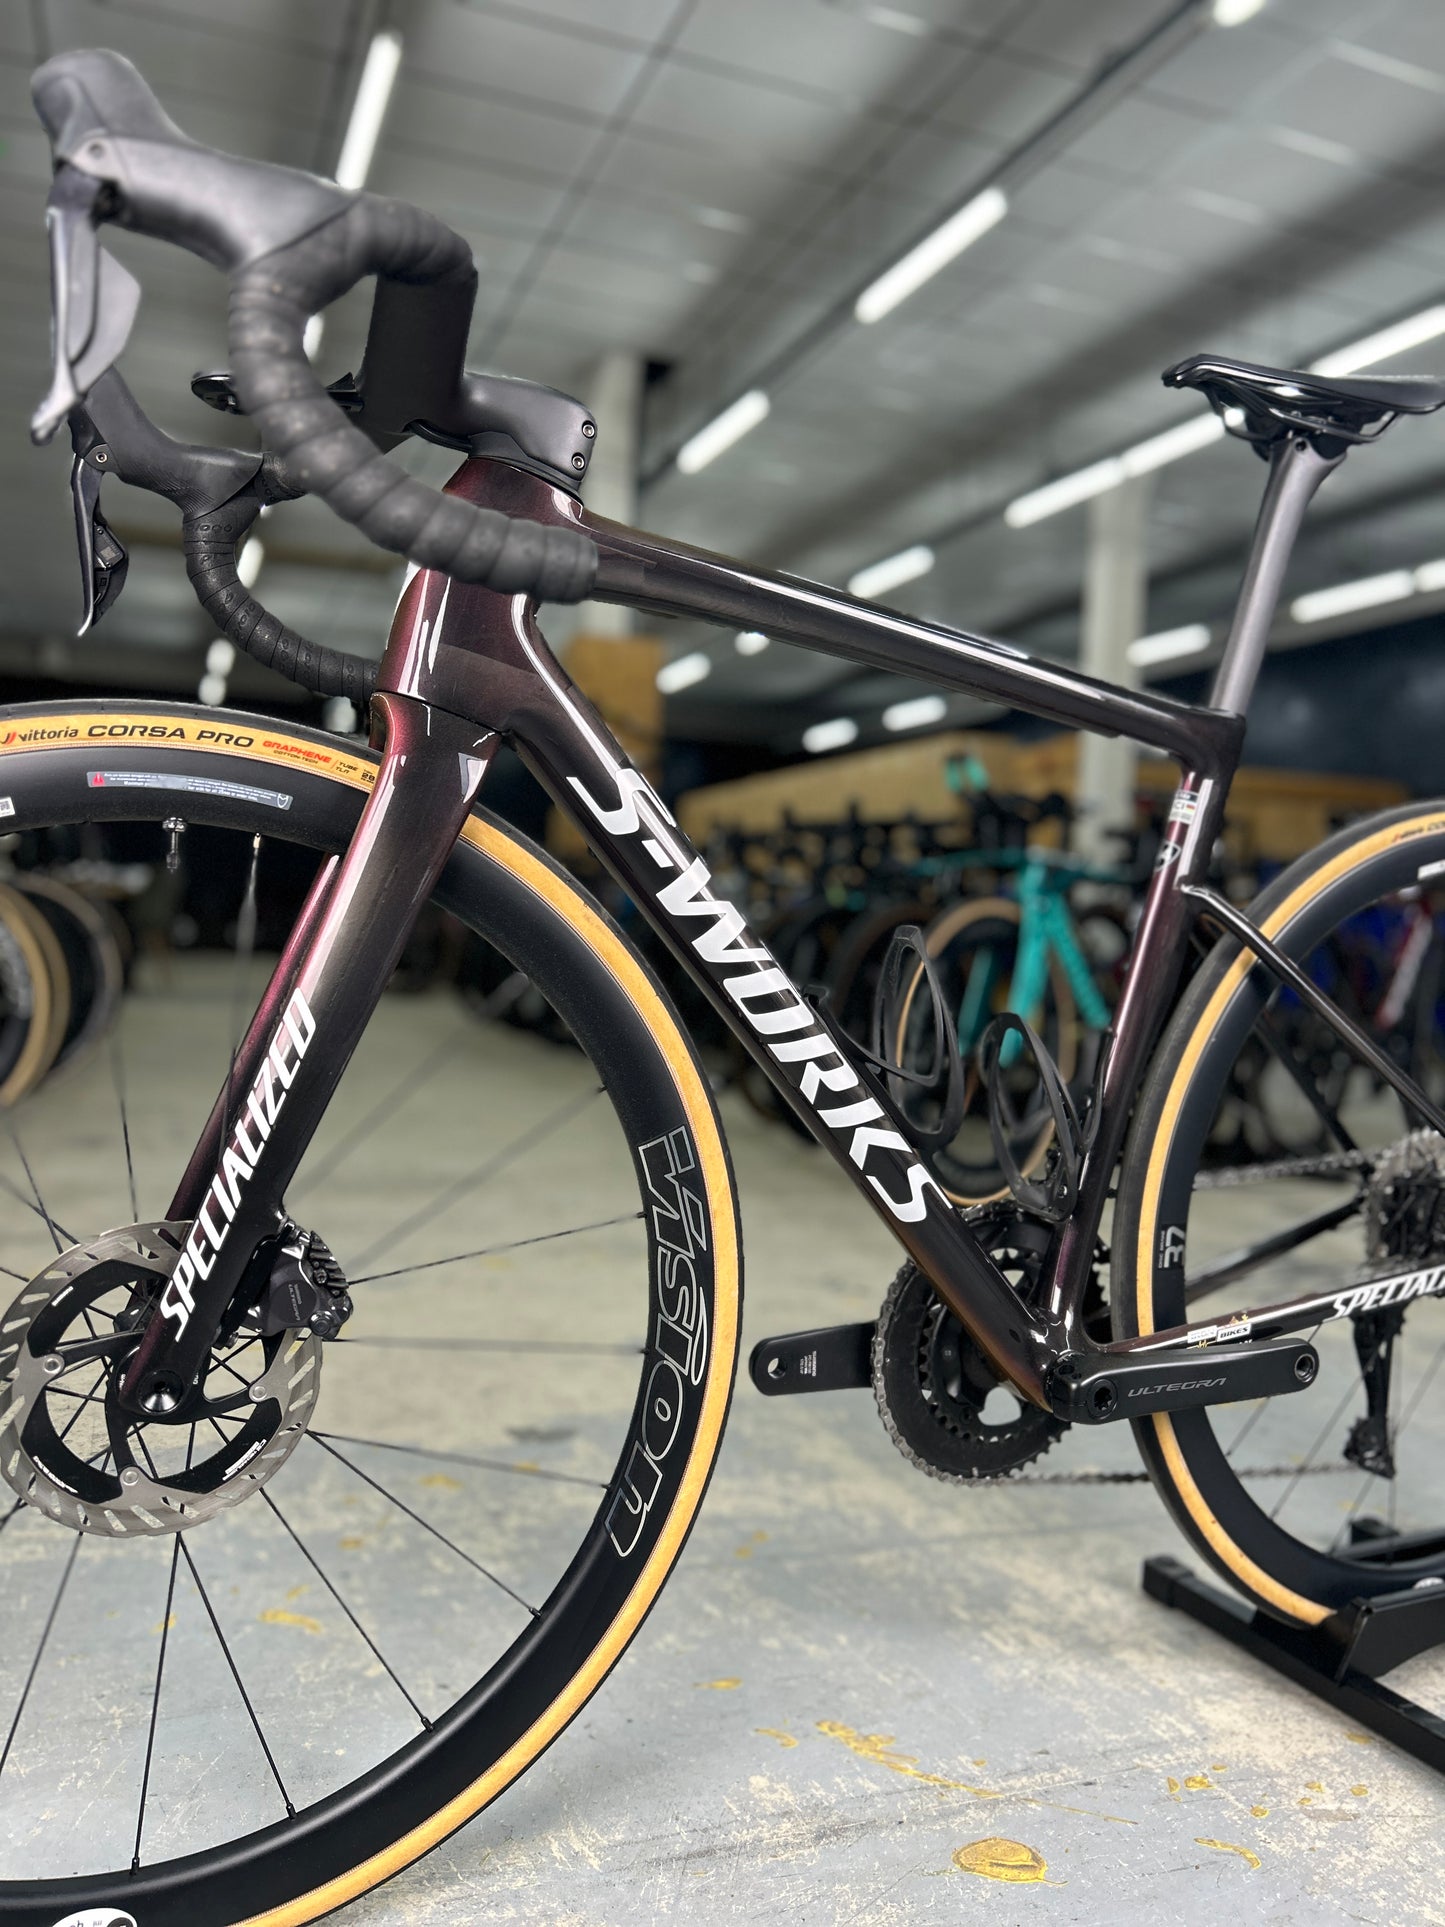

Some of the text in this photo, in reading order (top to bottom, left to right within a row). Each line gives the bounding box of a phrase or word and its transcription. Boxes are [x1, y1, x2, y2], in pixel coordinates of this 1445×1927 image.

[18, 725, 254, 748] vittoria CORSA PRO
[262, 740, 332, 763] GRAPHENE
[339, 761, 359, 771] TUBE
[566, 768, 953, 1223] S-WORKS
[160, 987, 317, 1342] SPECIALIZED
[1164, 1225, 1185, 1268] 37
[1220, 1326, 1249, 1339] BIKES
[1128, 1378, 1227, 1398] ULTEGRA
